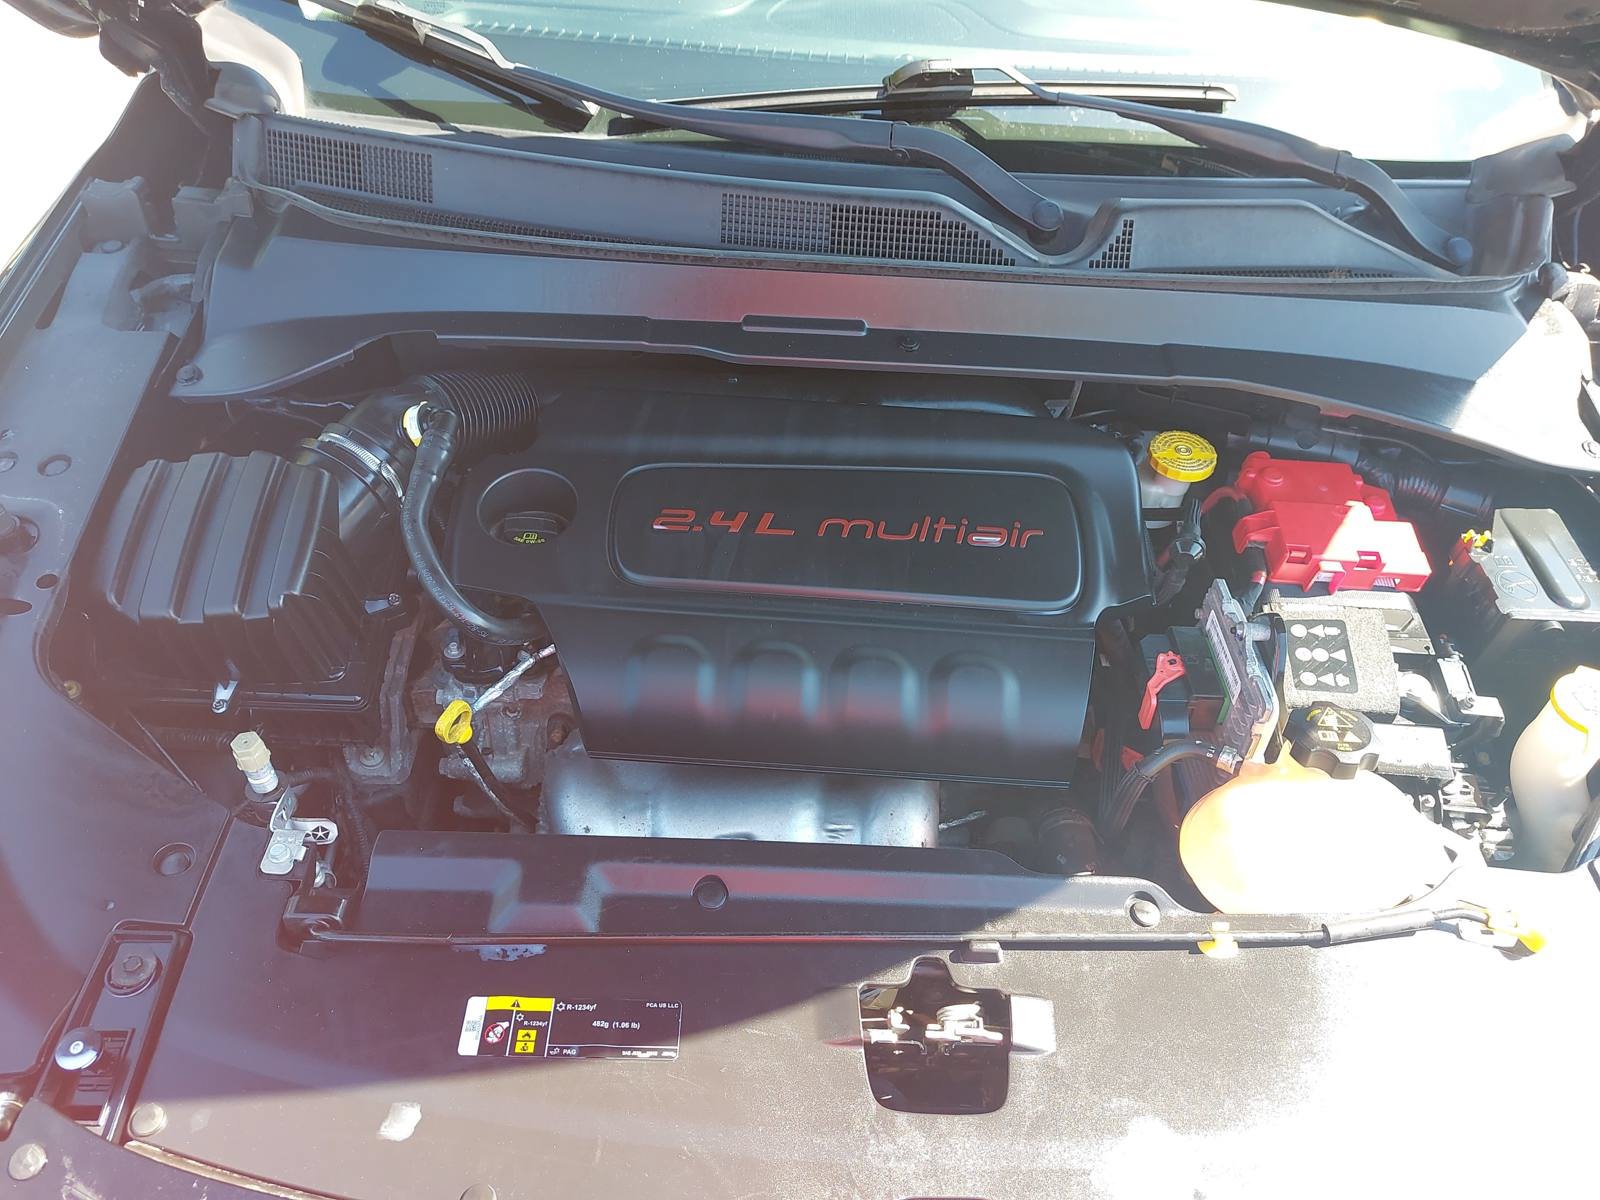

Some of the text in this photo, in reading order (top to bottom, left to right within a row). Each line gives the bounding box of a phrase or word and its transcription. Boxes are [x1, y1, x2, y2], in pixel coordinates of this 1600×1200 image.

[817, 515, 1044, 549] multiair
[566, 1003, 597, 1012] R-1234yf
[592, 1020, 609, 1028] 482g
[630, 1020, 640, 1030] lb)
